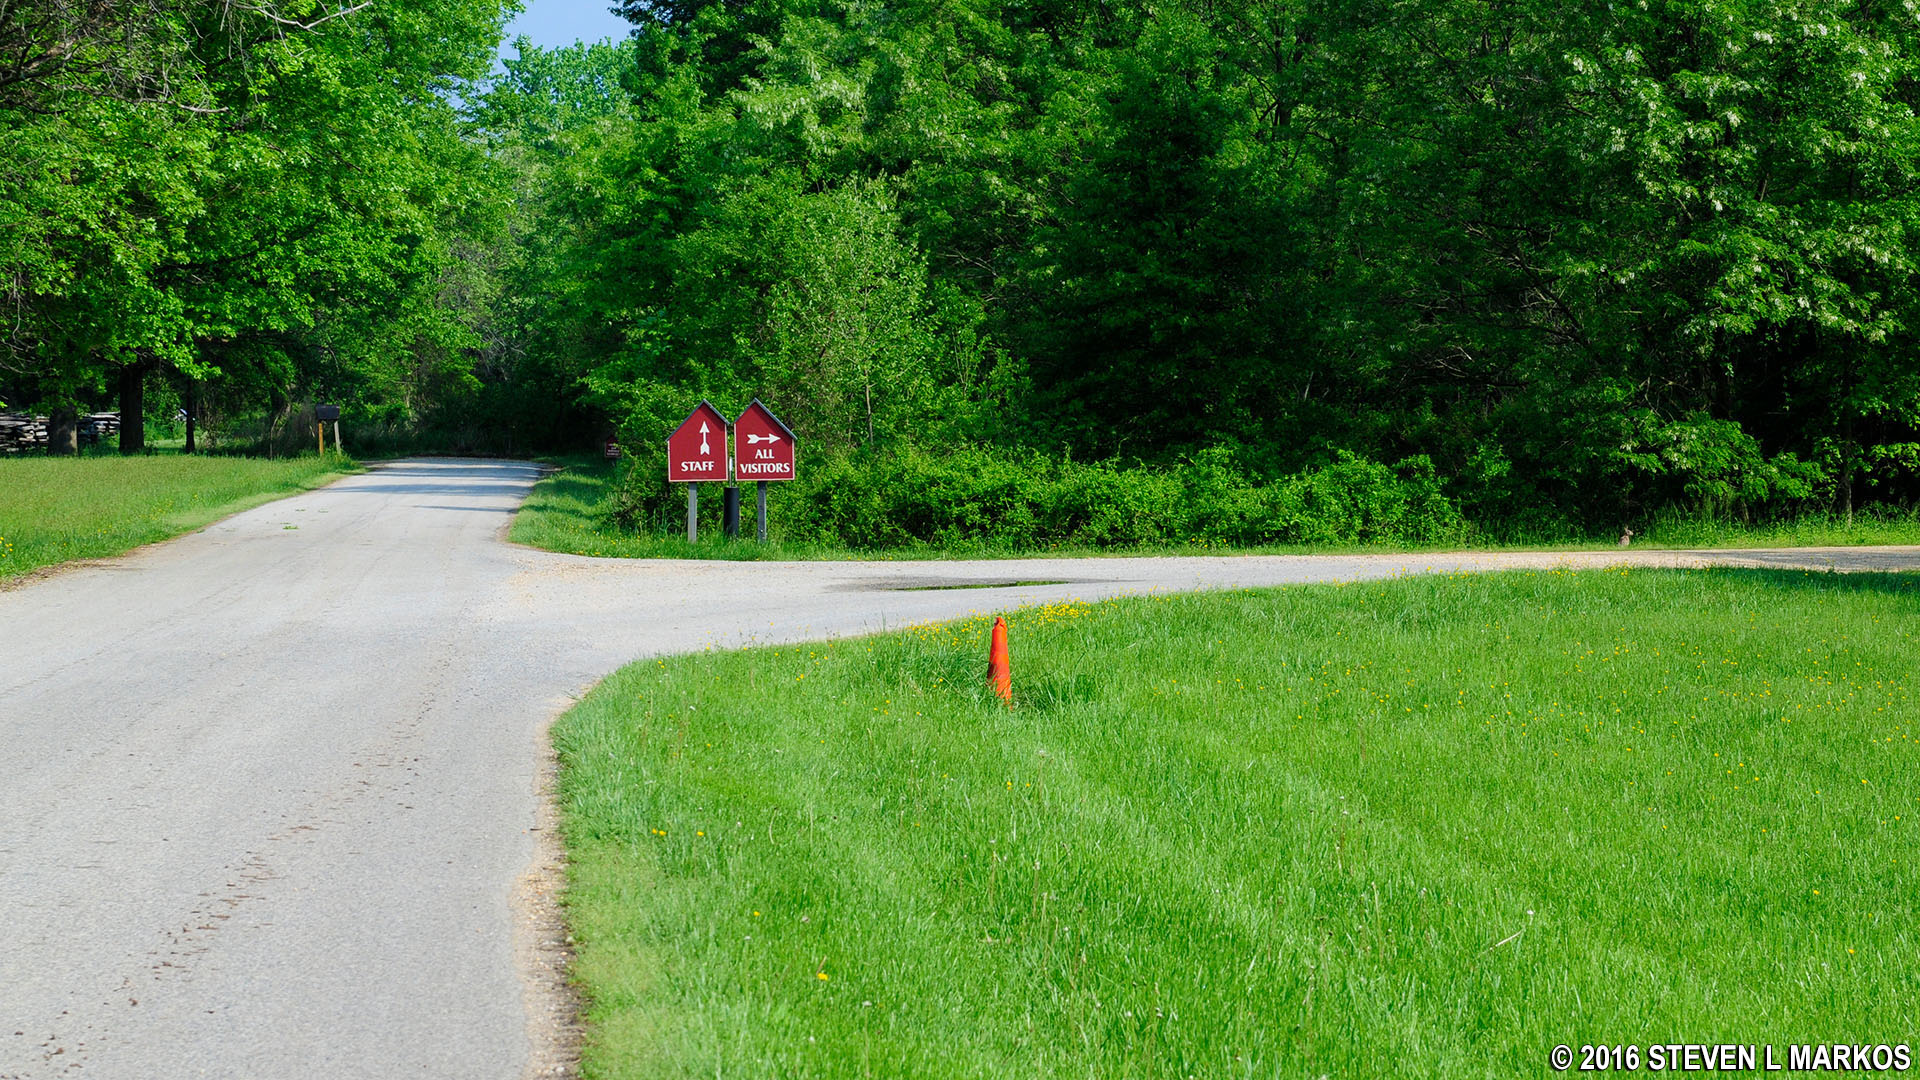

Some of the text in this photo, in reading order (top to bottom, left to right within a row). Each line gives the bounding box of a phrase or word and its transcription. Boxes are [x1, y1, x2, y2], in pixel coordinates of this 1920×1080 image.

[755, 449, 775, 459] ALL
[681, 461, 715, 472] STAFF
[740, 463, 790, 473] VISITORS
